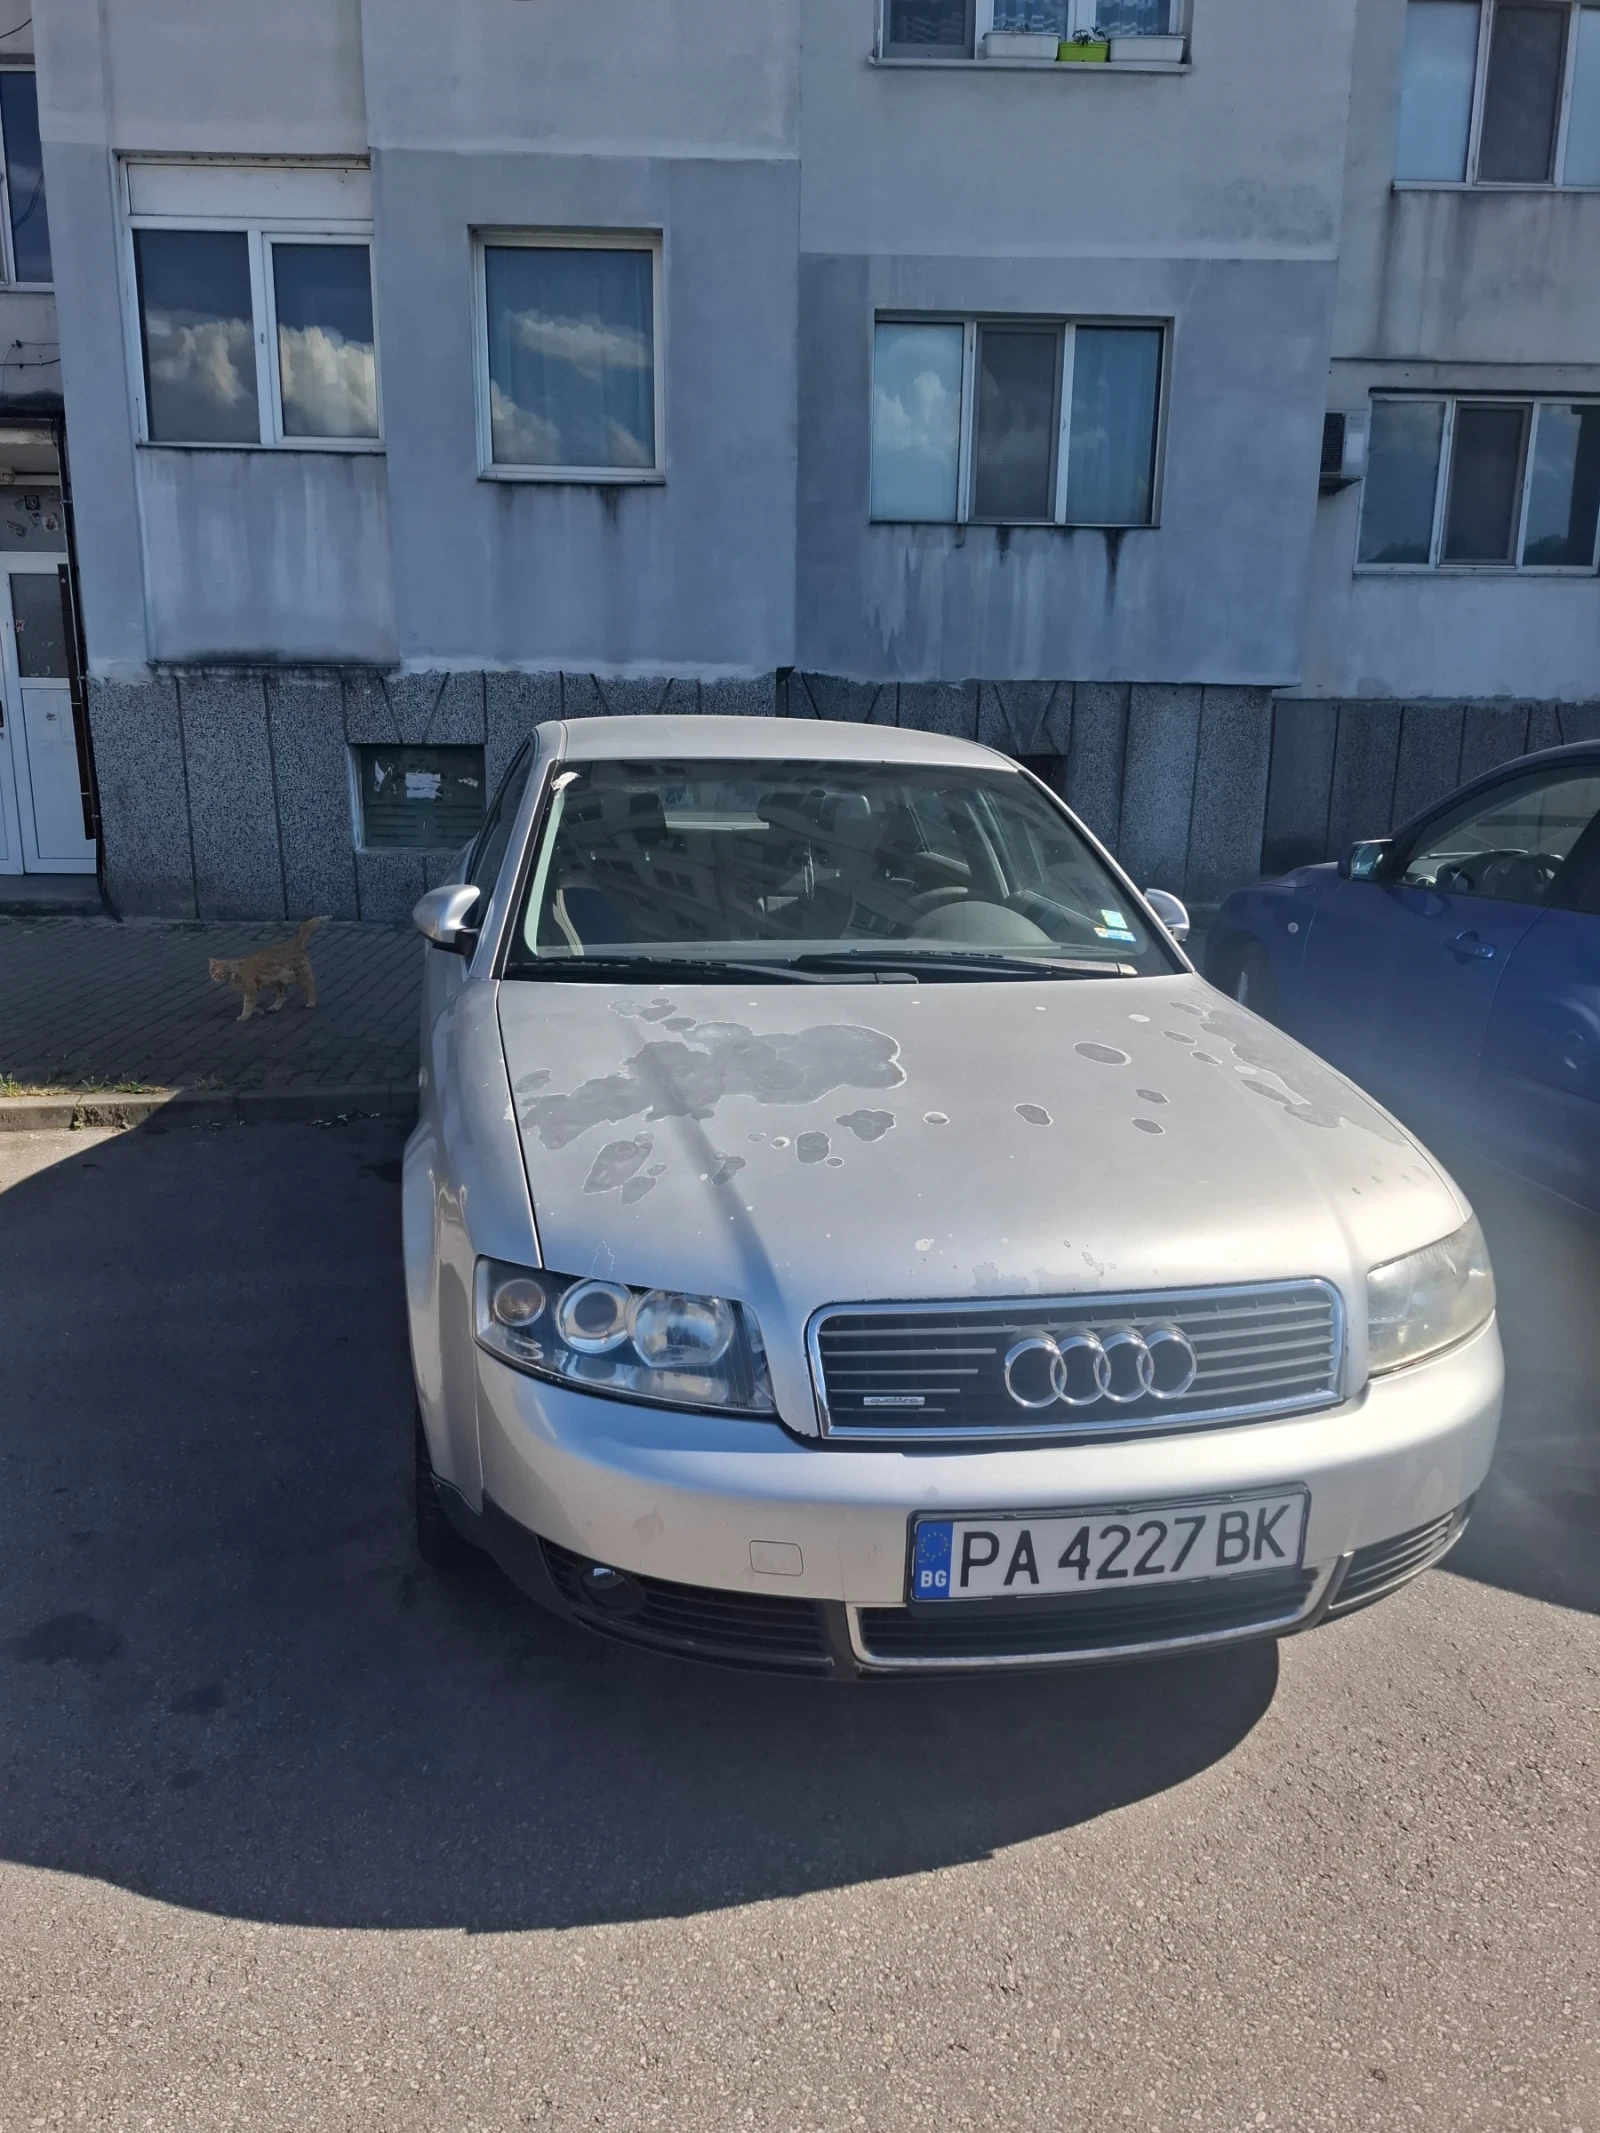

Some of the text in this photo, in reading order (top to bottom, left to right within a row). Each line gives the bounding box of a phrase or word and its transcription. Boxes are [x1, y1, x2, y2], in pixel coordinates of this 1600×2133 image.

[959, 1504, 1291, 1588] PA 4227 BK
[920, 1569, 947, 1589] BG
